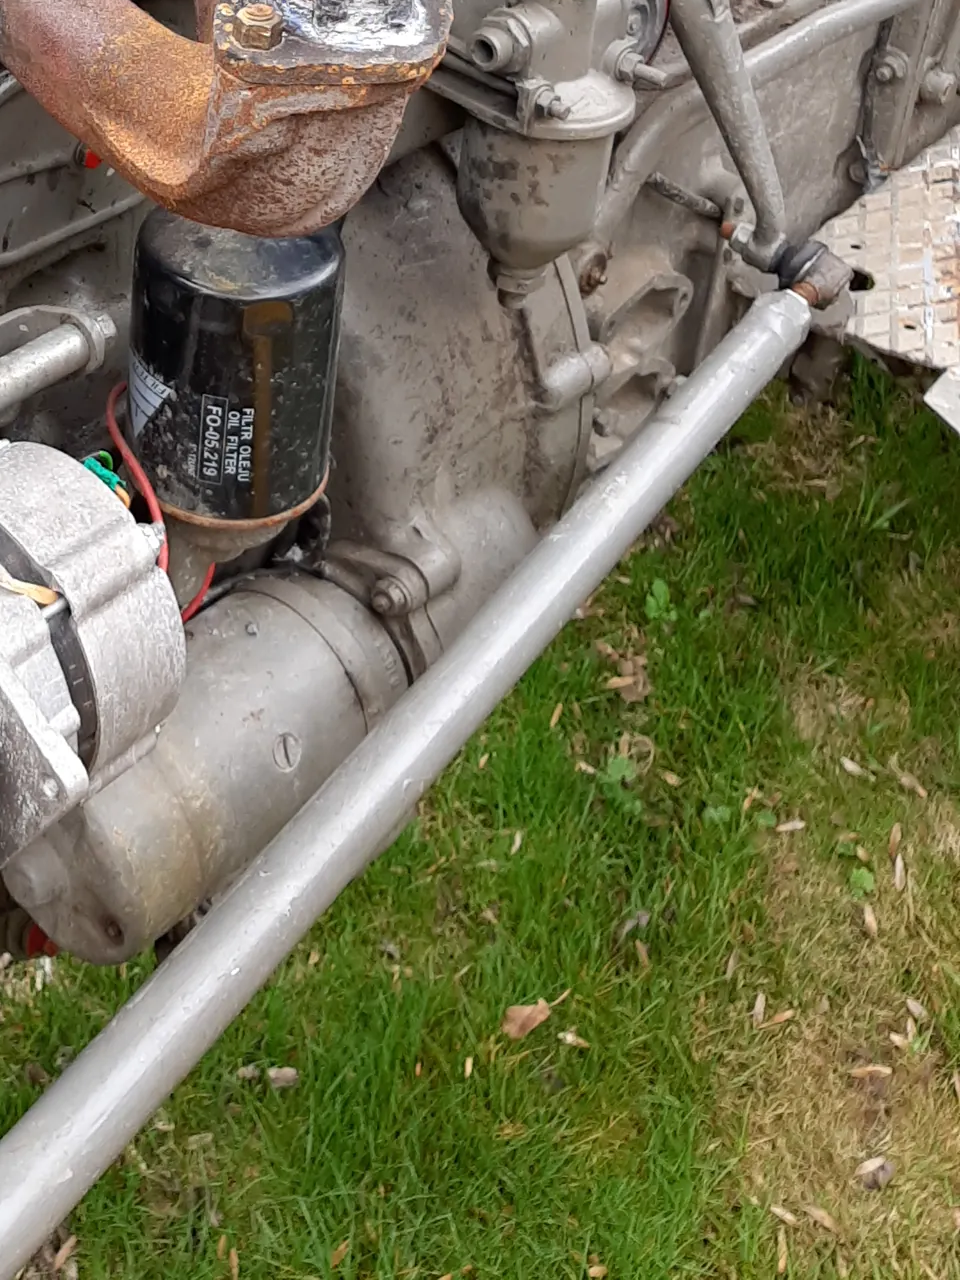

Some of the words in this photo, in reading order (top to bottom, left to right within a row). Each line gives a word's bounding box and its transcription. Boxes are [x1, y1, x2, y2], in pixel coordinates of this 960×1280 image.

[228, 411, 240, 430] OIL
[240, 408, 255, 441] FILTR
[203, 404, 222, 477] FO-05.219
[224, 435, 238, 475] FILTER
[237, 445, 251, 482] OLEJU
